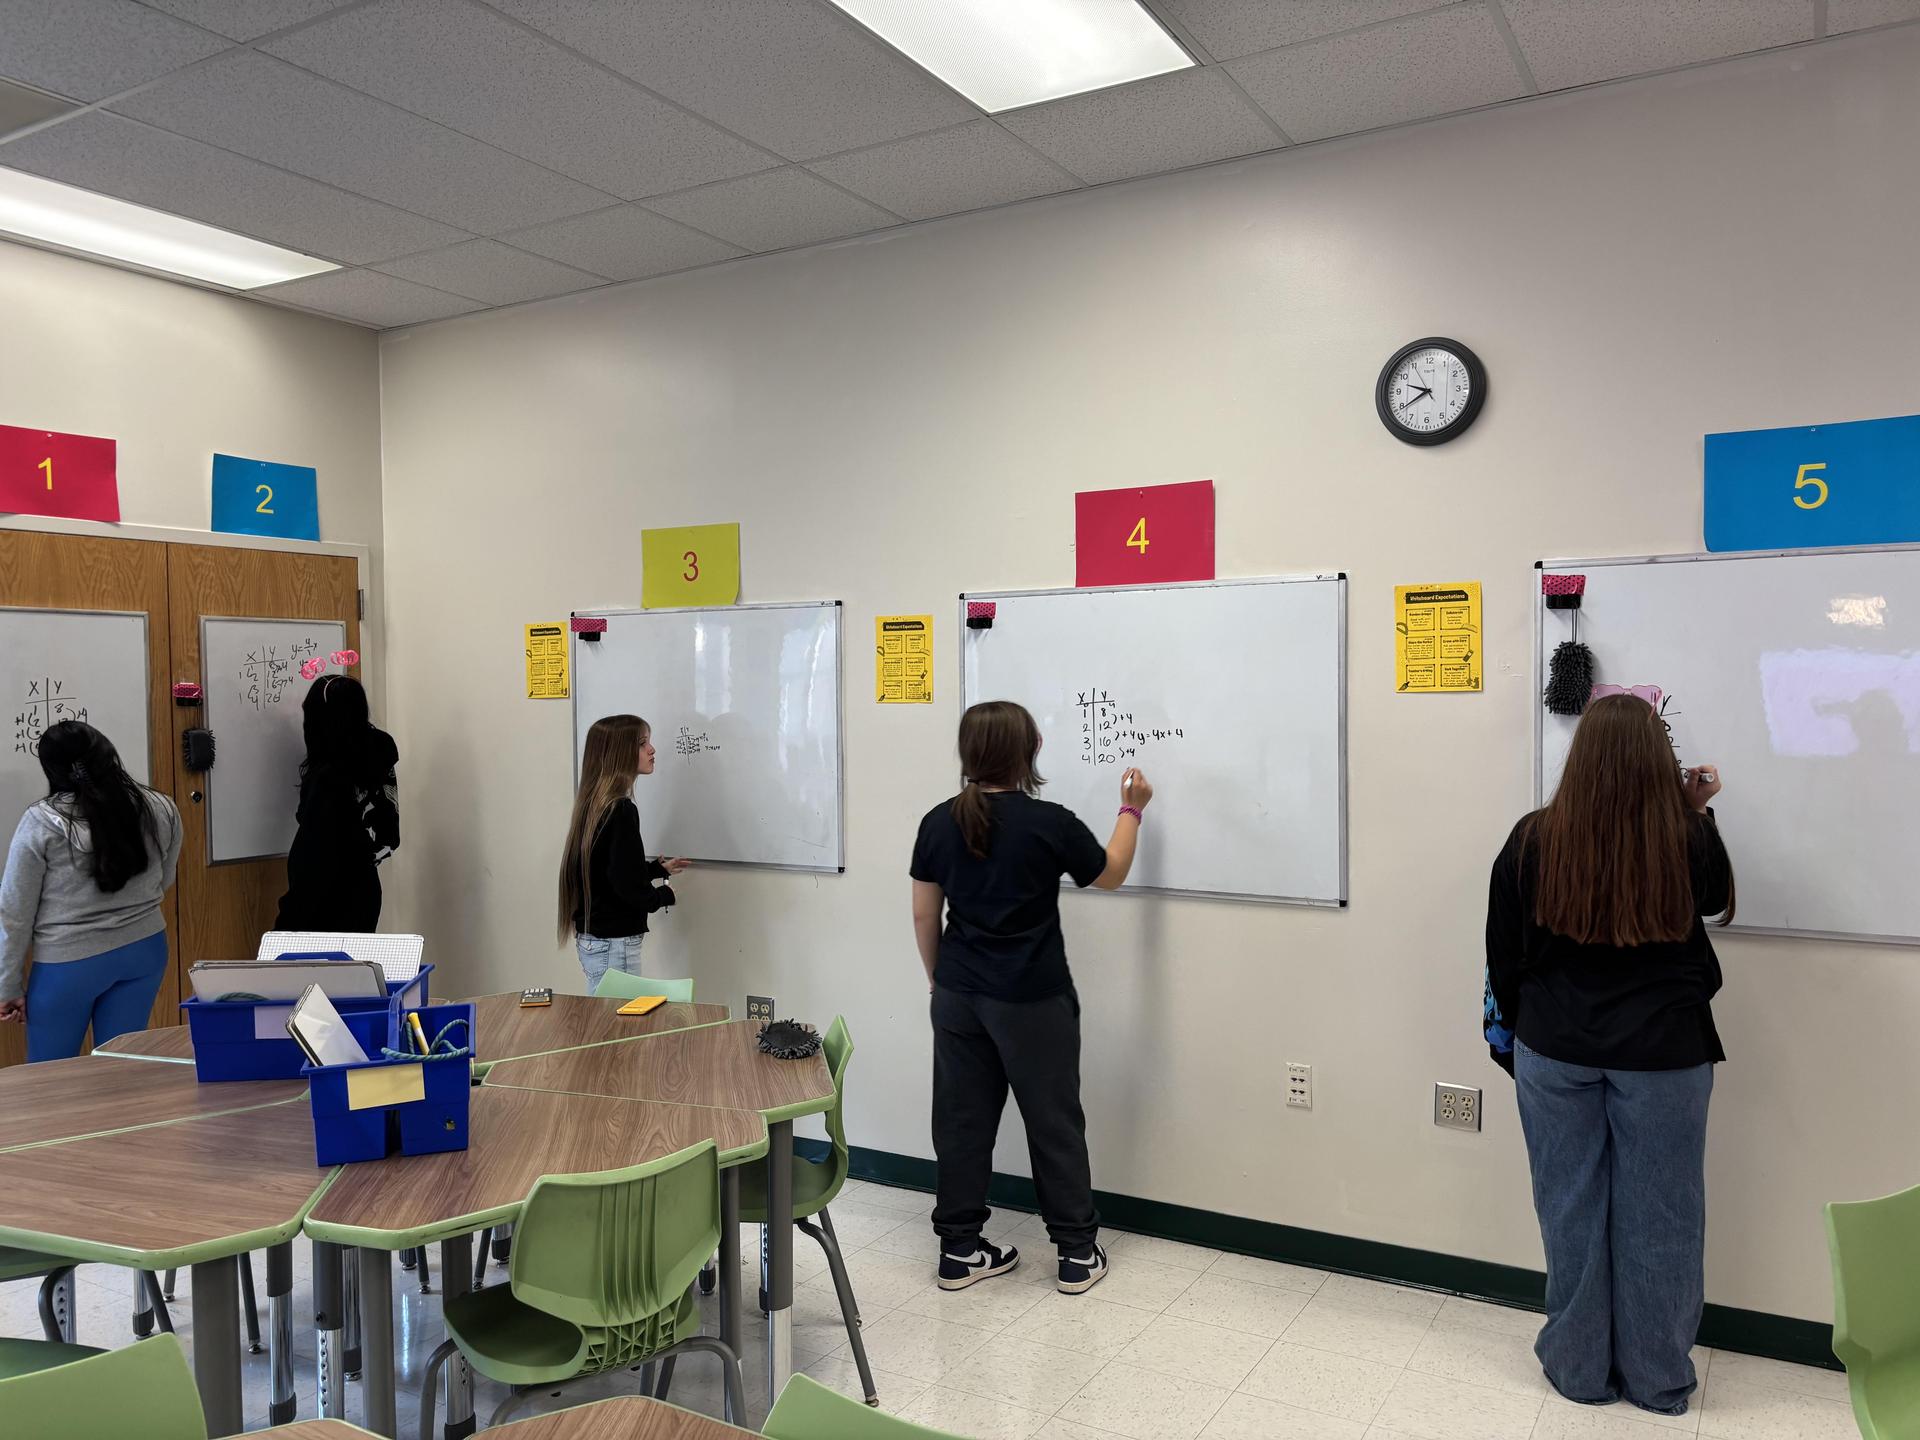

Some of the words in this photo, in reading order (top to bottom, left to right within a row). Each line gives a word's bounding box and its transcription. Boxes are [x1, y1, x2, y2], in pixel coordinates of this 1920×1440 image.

[38, 456, 53, 490] 1
[1792, 463, 1829, 510] 5
[255, 484, 274, 514] 2
[1126, 517, 1150, 554] 4
[683, 550, 699, 582] 3
[246, 651, 256, 662] X
[28, 680, 40, 697] X
[54, 680, 62, 694] Y
[54, 703, 64, 714] 8
[1100, 707, 1107, 717] 8
[1082, 723, 1091, 733] 2
[1099, 720, 1112, 731] 12
[1083, 737, 1092, 750] 3
[1099, 736, 1112, 747] 16
[1081, 754, 1091, 764] 4
[1098, 753, 1116, 764] 20
